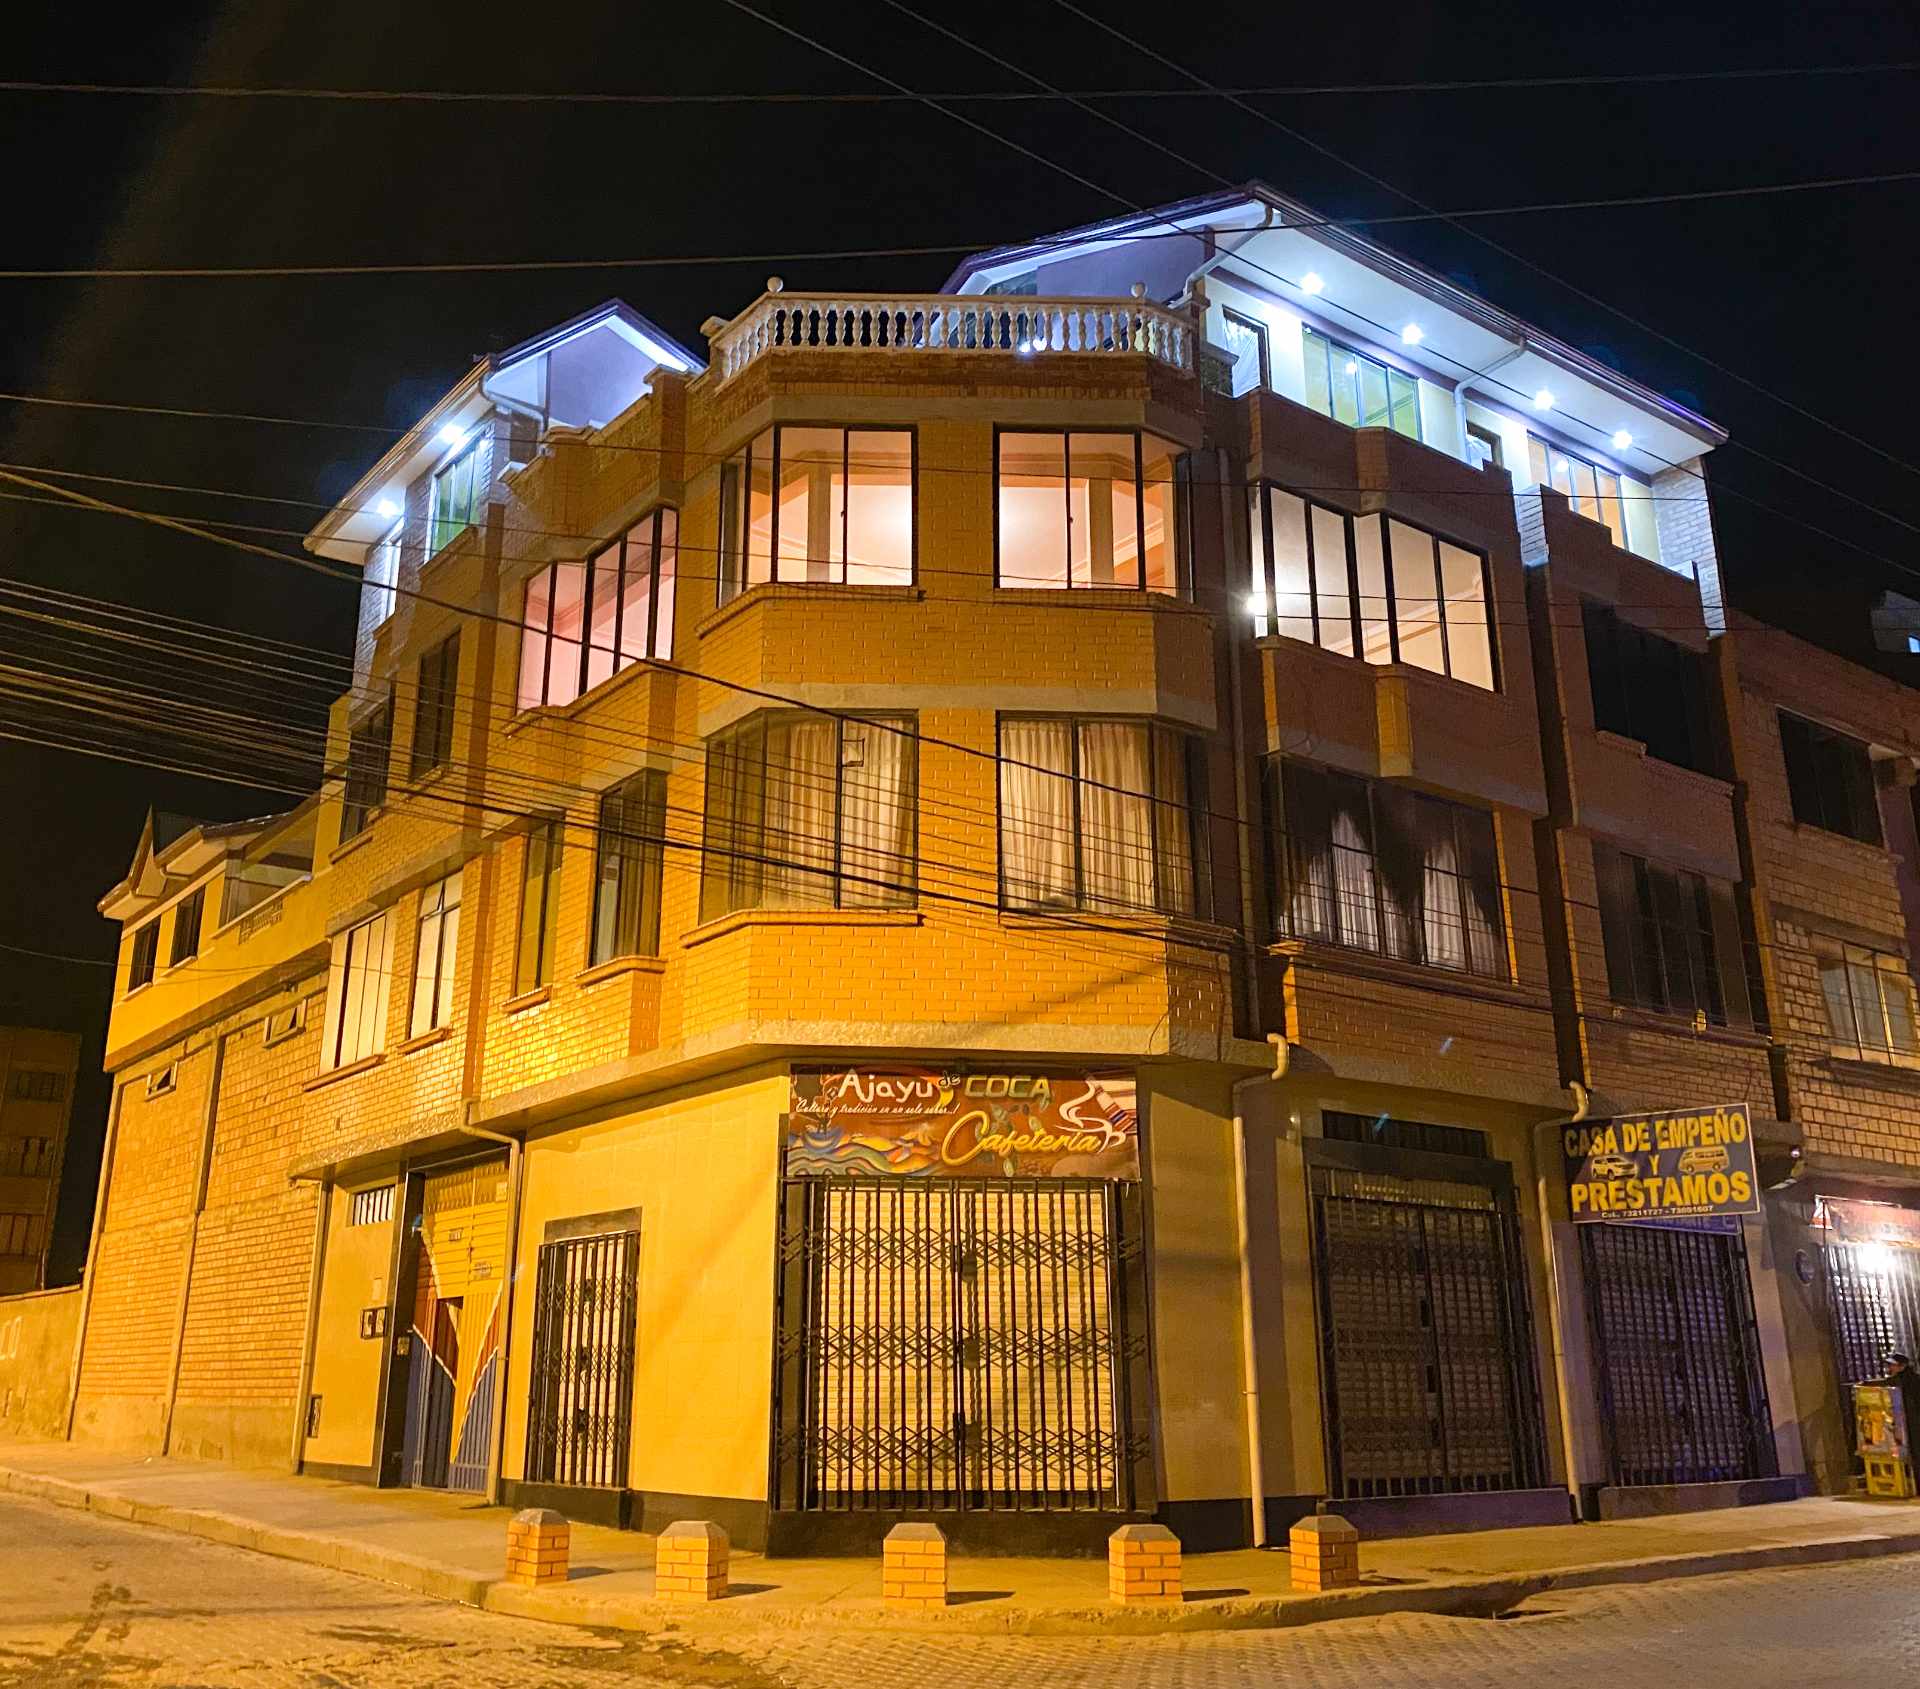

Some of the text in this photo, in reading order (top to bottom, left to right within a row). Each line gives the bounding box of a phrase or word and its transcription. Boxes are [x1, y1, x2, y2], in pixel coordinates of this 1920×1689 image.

[838, 1069, 1050, 1102] Ajayu de COCA
[1564, 1109, 1746, 1157] CASA DE EMPEÑO
[1649, 1154, 1660, 1175] Y
[1571, 1172, 1750, 1213] PRESTAMOS
